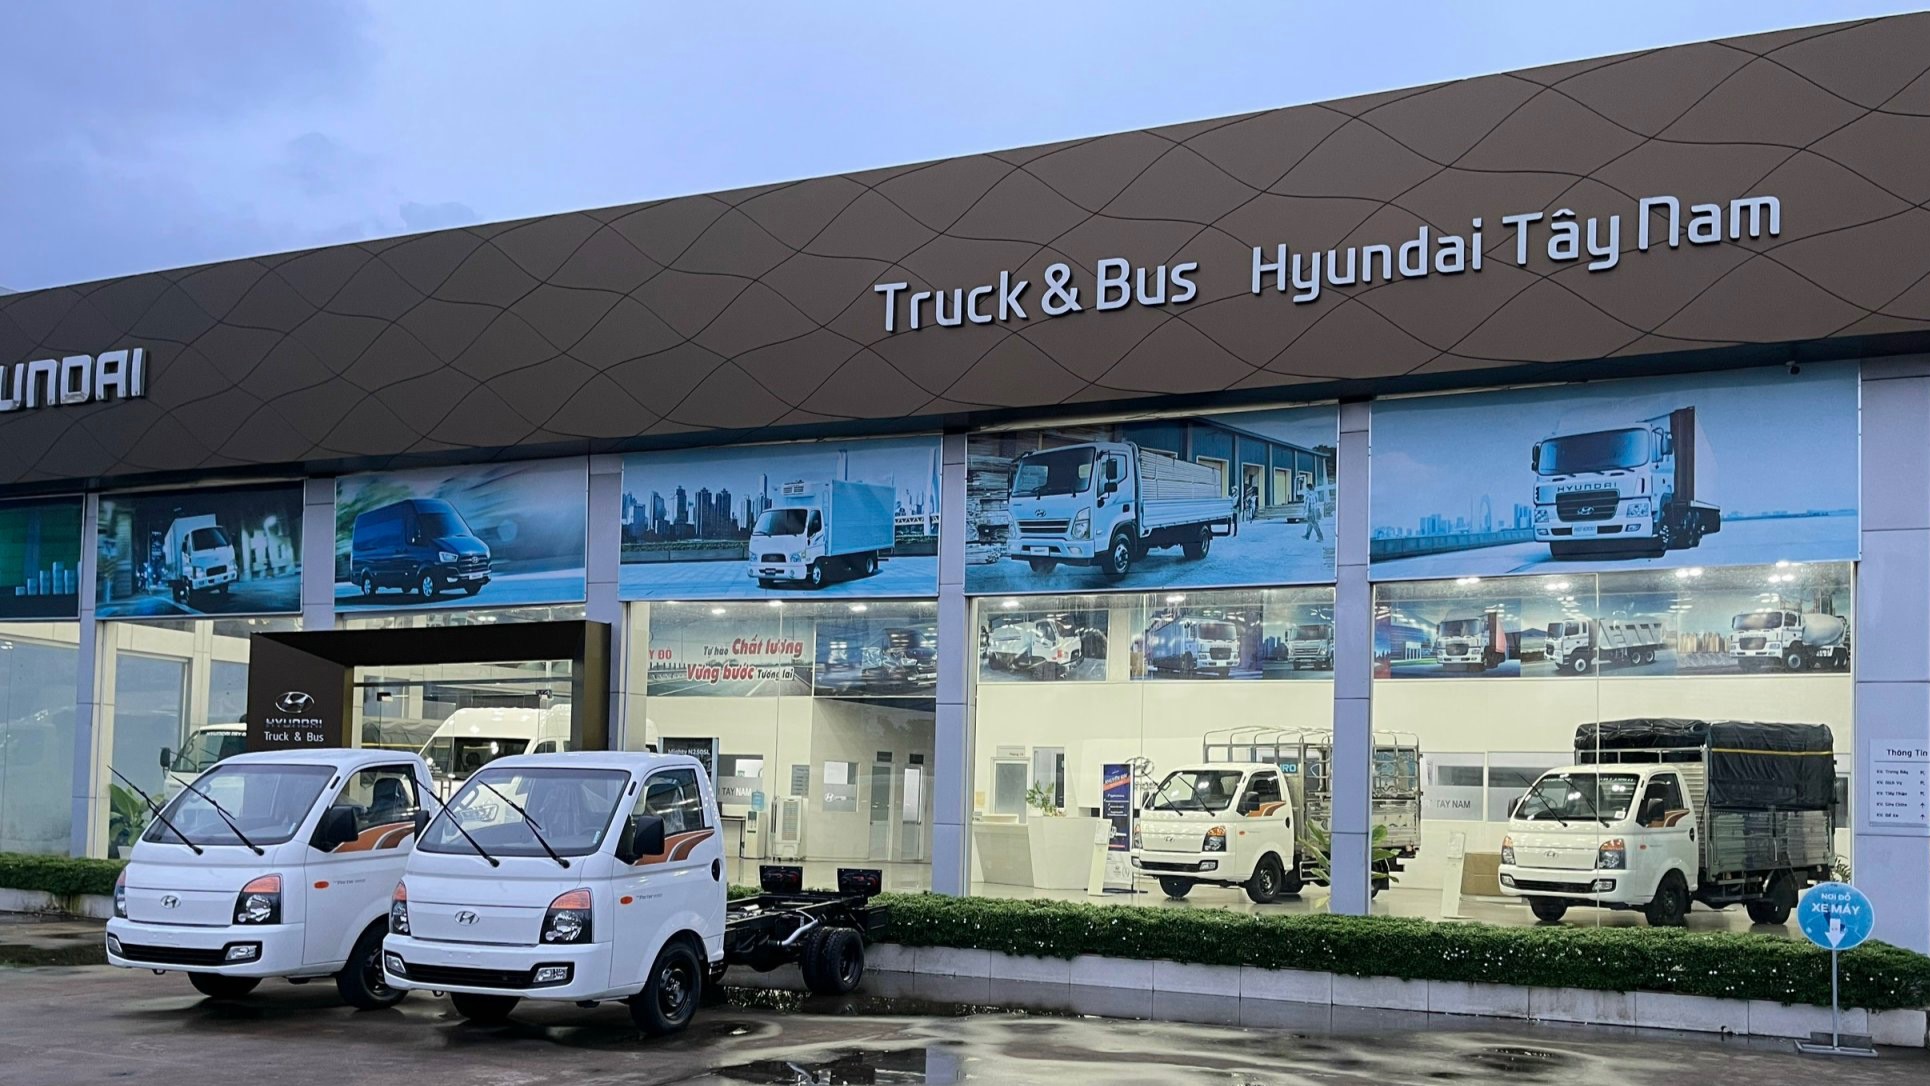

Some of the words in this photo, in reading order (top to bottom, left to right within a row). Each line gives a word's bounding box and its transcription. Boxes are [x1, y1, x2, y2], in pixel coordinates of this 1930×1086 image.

[1251, 216, 1483, 303] Hyundai
[1502, 208, 1620, 272] Tây
[1637, 195, 1781, 251] Nam
[873, 280, 1031, 332] Truck
[1040, 262, 1083, 316] &
[1096, 257, 1198, 311] Bus
[1557, 481, 1617, 493] HYUNDAI
[264, 730, 290, 742] Truck
[293, 731, 302, 742] &
[306, 731, 325, 743] Bus
[1886, 748, 1913, 758] Thông
[1915, 748, 1928, 757] Tin
[1811, 902, 1829, 913] XE
[1830, 902, 1860, 915] MÁY
